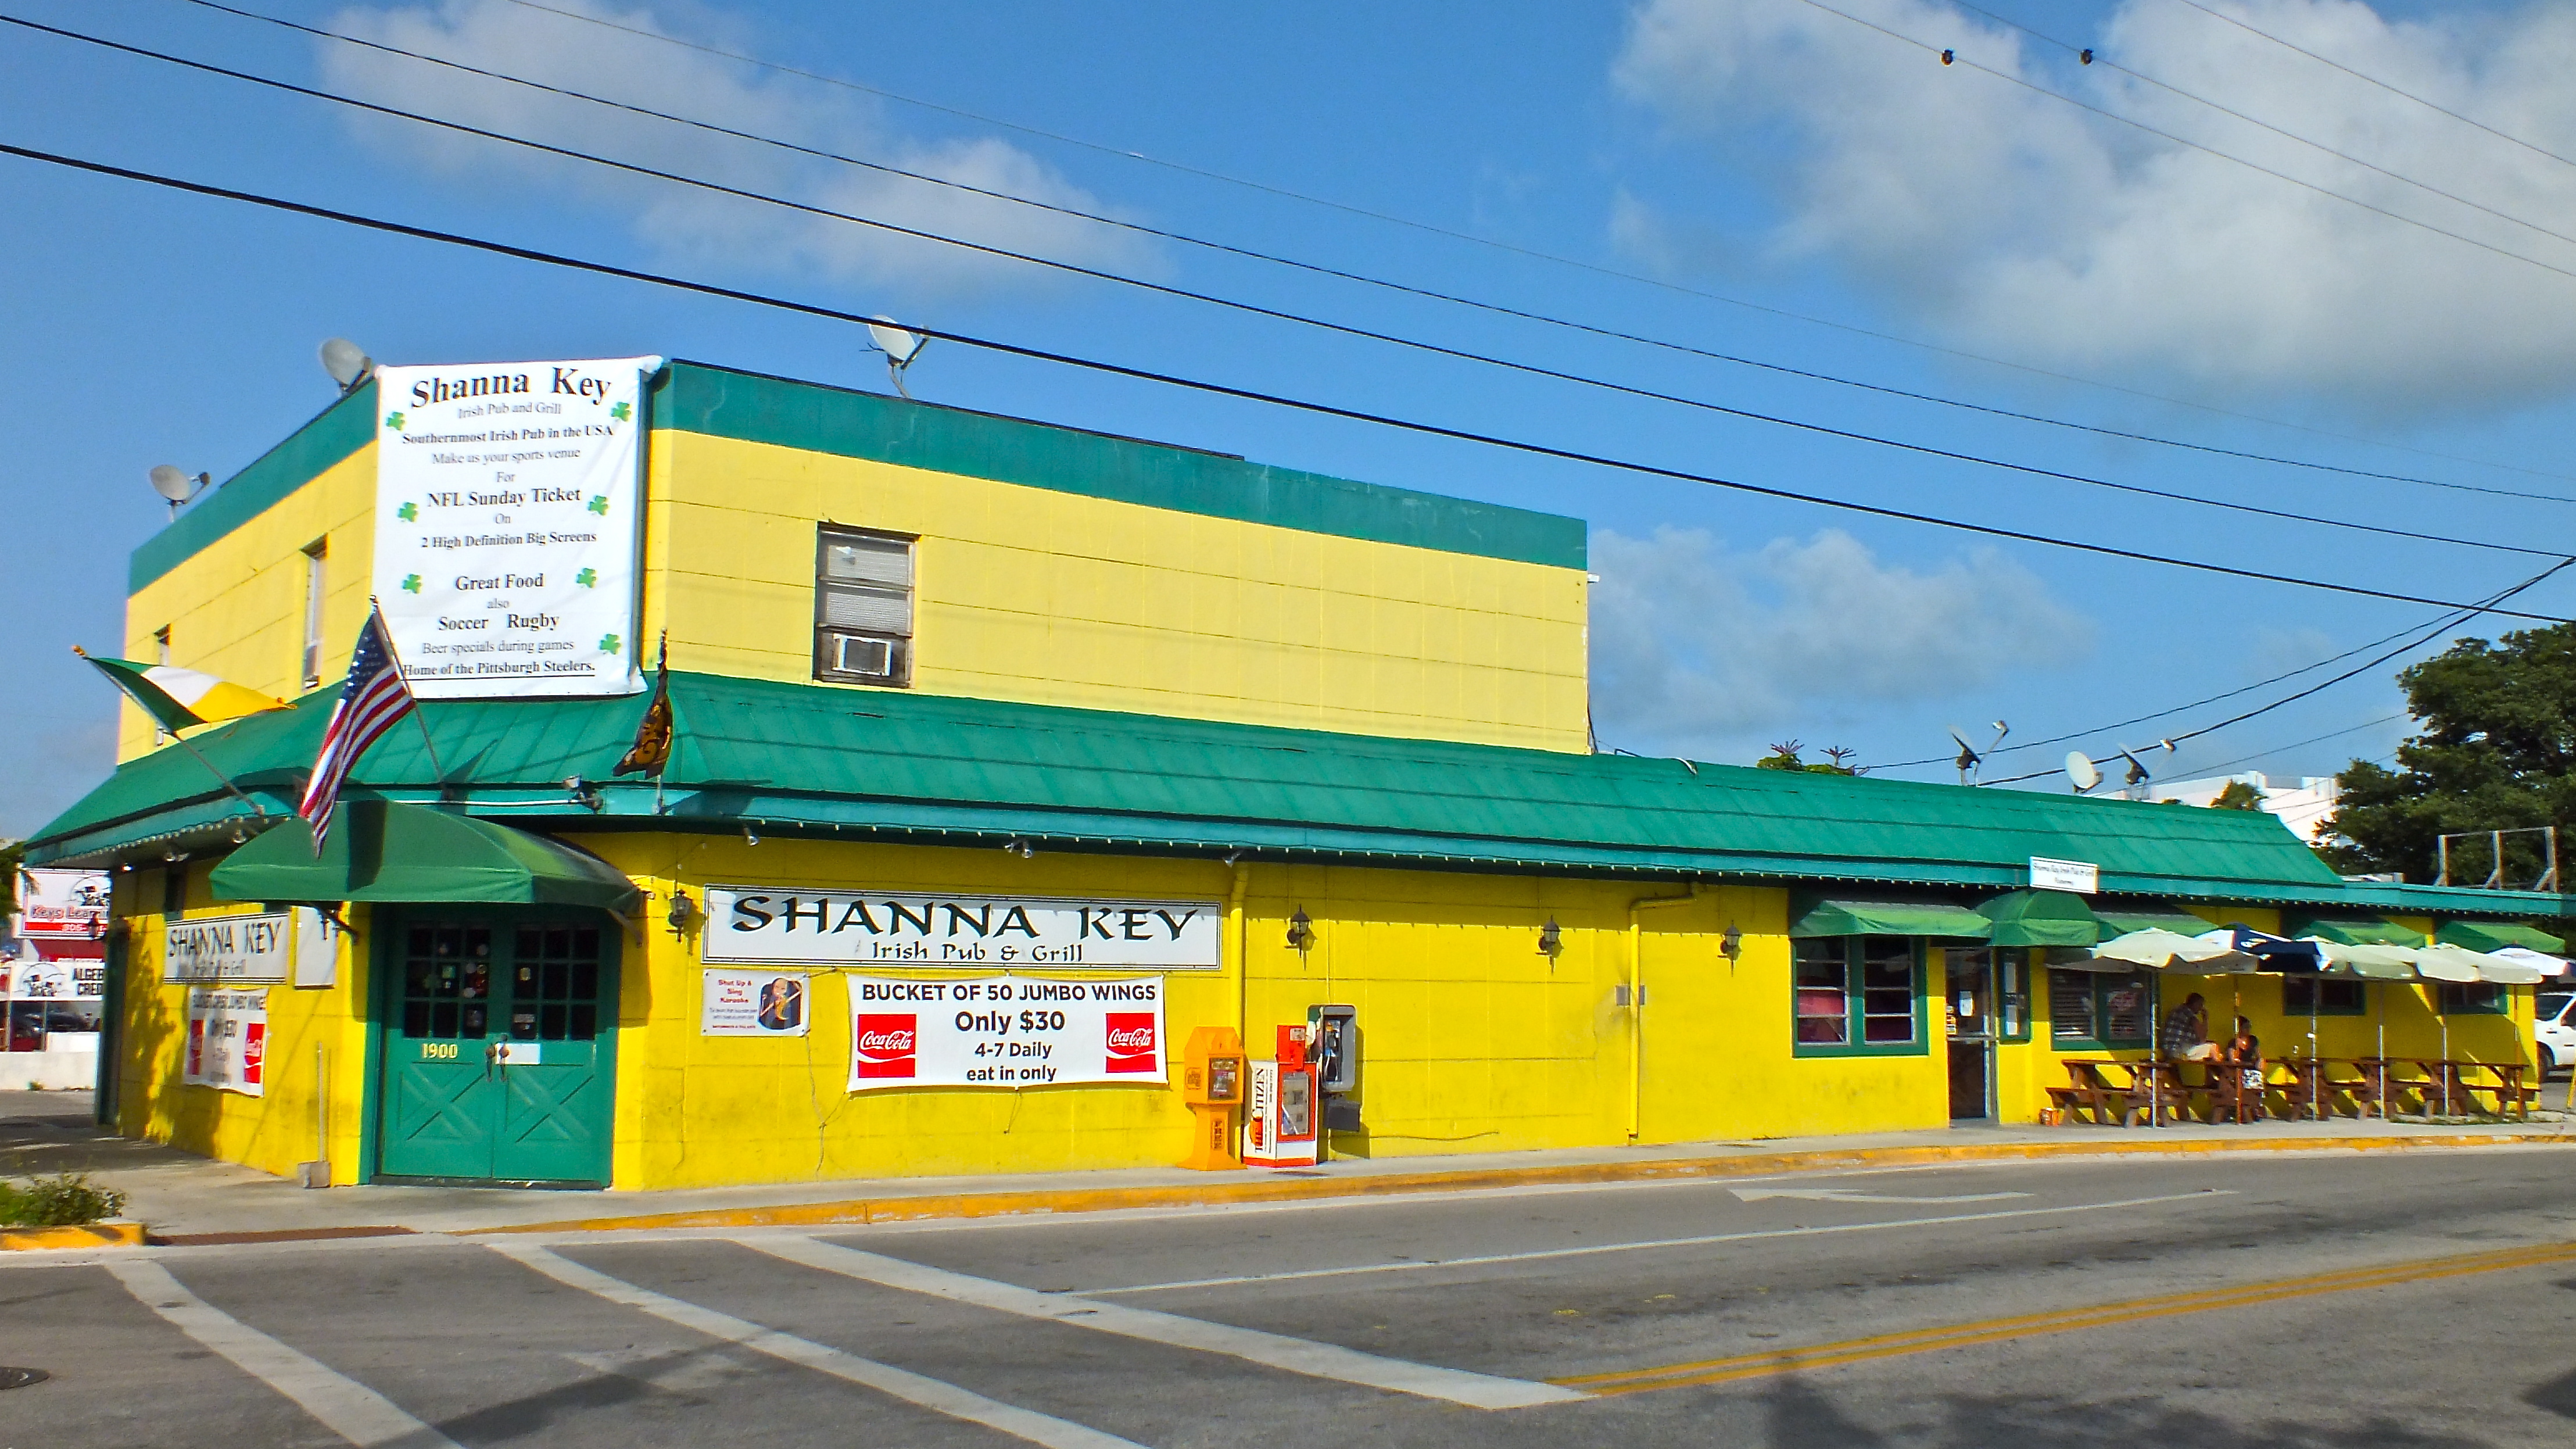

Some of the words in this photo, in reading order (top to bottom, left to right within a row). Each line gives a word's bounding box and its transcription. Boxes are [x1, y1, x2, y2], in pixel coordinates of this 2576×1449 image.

[411, 373, 529, 407] Shanna
[551, 367, 611, 405] Key
[458, 407, 483, 418] Irish
[488, 403, 509, 414] Pub
[512, 402, 532, 413] and
[536, 403, 561, 414] Grill
[403, 431, 486, 444] Southernmost
[490, 430, 518, 441] Irish
[522, 429, 544, 439] Pub
[549, 428, 560, 438] in
[563, 427, 581, 438] the
[585, 425, 614, 436] USA
[433, 453, 464, 464] Make
[468, 455, 479, 463] us
[483, 453, 508, 466] your
[512, 450, 543, 463] sports
[548, 449, 580, 459] venue
[497, 472, 515, 482] For
[428, 492, 463, 507] NFL
[469, 491, 525, 507] Sunday
[531, 488, 581, 503] Ticket
[495, 514, 511, 524] On
[421, 538, 428, 548] 2
[433, 536, 461, 550] High
[465, 535, 522, 546] Definition
[527, 534, 546, 545] Big
[550, 532, 597, 543] Screens
[456, 577, 500, 591] Great
[504, 573, 544, 588] Food
[488, 599, 509, 609] also
[438, 617, 489, 631] Soccer
[507, 614, 559, 631] Rugby
[422, 643, 447, 654] Beer
[451, 642, 494, 655] specials
[499, 641, 535, 653] during
[538, 641, 574, 653] games
[403, 664, 437, 675] Home
[440, 664, 453, 674] of
[456, 663, 474, 674] the
[478, 662, 540, 674] Pittsburgh
[544, 661, 594, 672] Steelers.
[732, 896, 1040, 939] SHANNA
[1077, 907, 1198, 940] KEY
[169, 925, 235, 957] SHANNA
[245, 921, 282, 954] KEY
[873, 940, 928, 959] Irish
[941, 942, 986, 960] Pub
[1001, 945, 1019, 961] &
[1032, 943, 1082, 962] Grill
[862, 984, 946, 1000] BUCKET
[953, 985, 981, 1000] OF
[988, 985, 1012, 1000] 50
[1019, 985, 1085, 1001] JUMBO
[1091, 985, 1155, 1000] WINGS
[955, 1011, 1012, 1035] Only
[1019, 1010, 1065, 1033] $30
[422, 1043, 458, 1058] 1900
[974, 1043, 1004, 1057] 4-7
[1009, 1042, 1052, 1059] Daily
[966, 1066, 994, 1081] eat
[1000, 1066, 1015, 1081] in
[1020, 1065, 1056, 1082] only
[1252, 1068, 1264, 1122] CITIZEN
